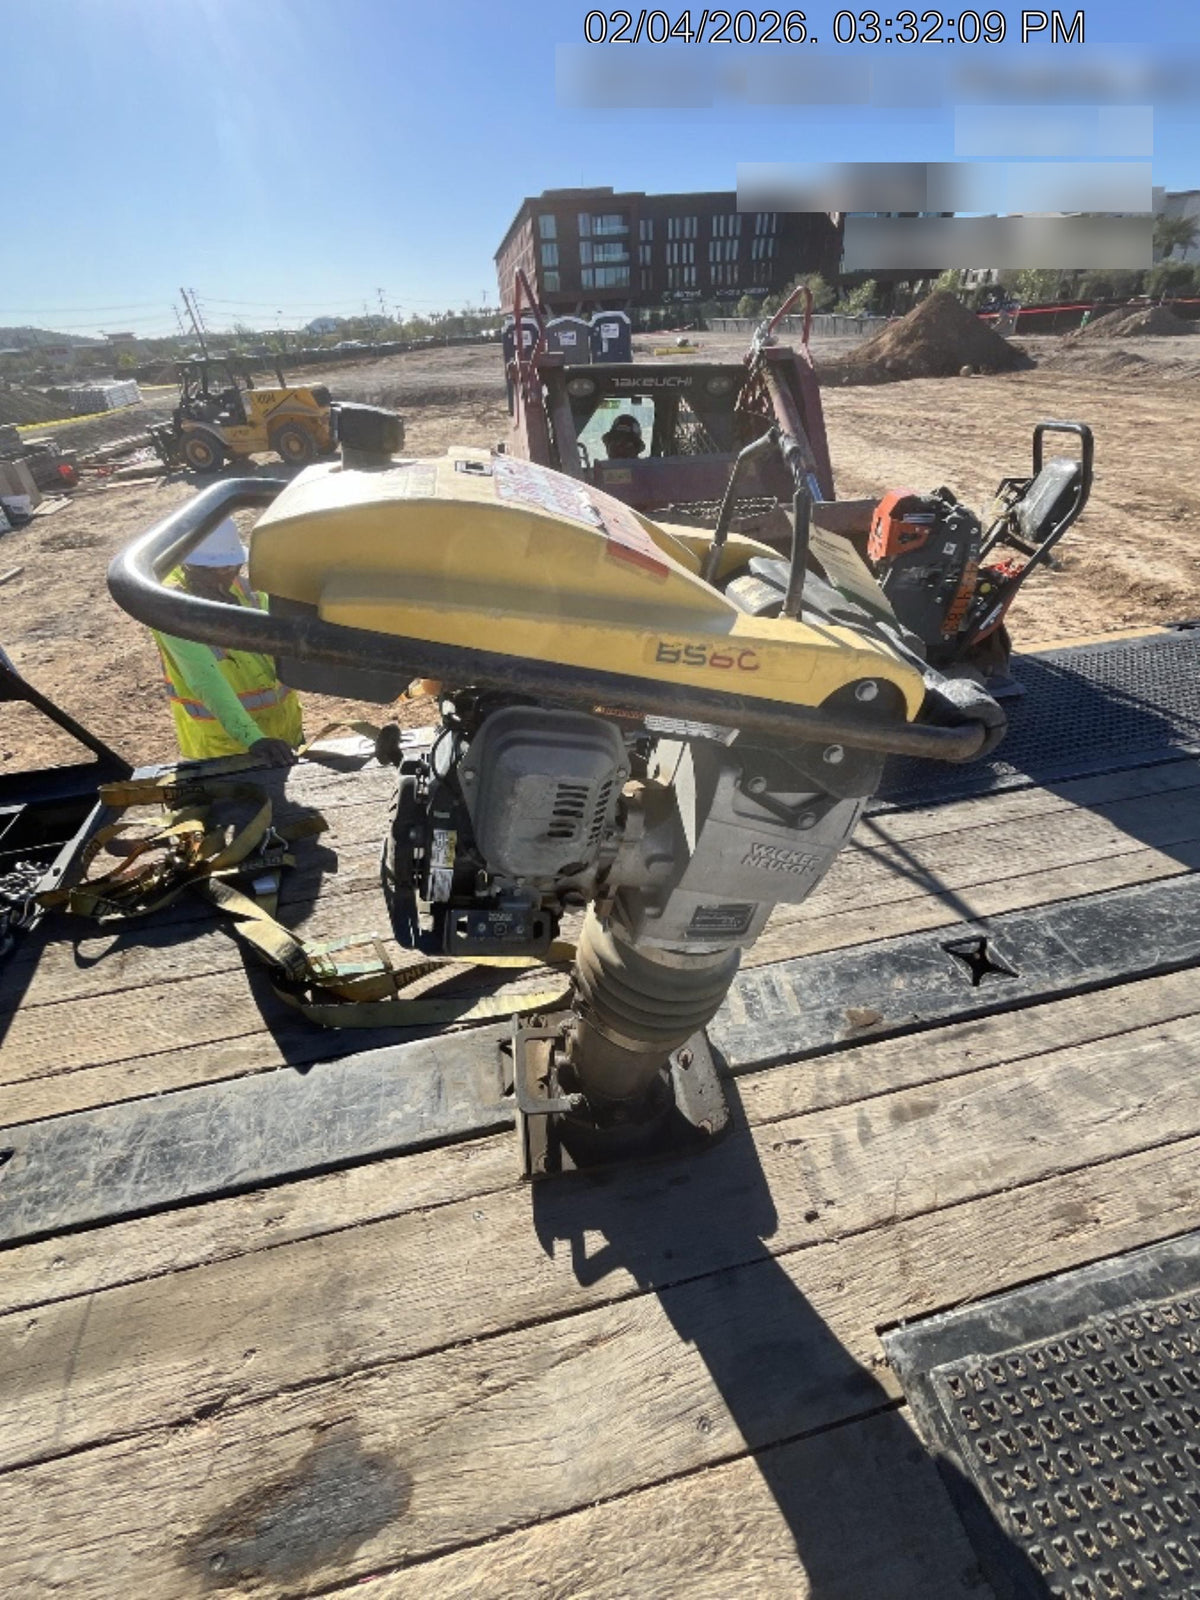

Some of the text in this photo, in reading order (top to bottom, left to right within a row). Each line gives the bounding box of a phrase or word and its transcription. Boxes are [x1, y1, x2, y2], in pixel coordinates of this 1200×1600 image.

[611, 376, 693, 387] TAKEUCHI
[741, 854, 816, 876] NEUSON
[751, 842, 822, 868] WACKER
